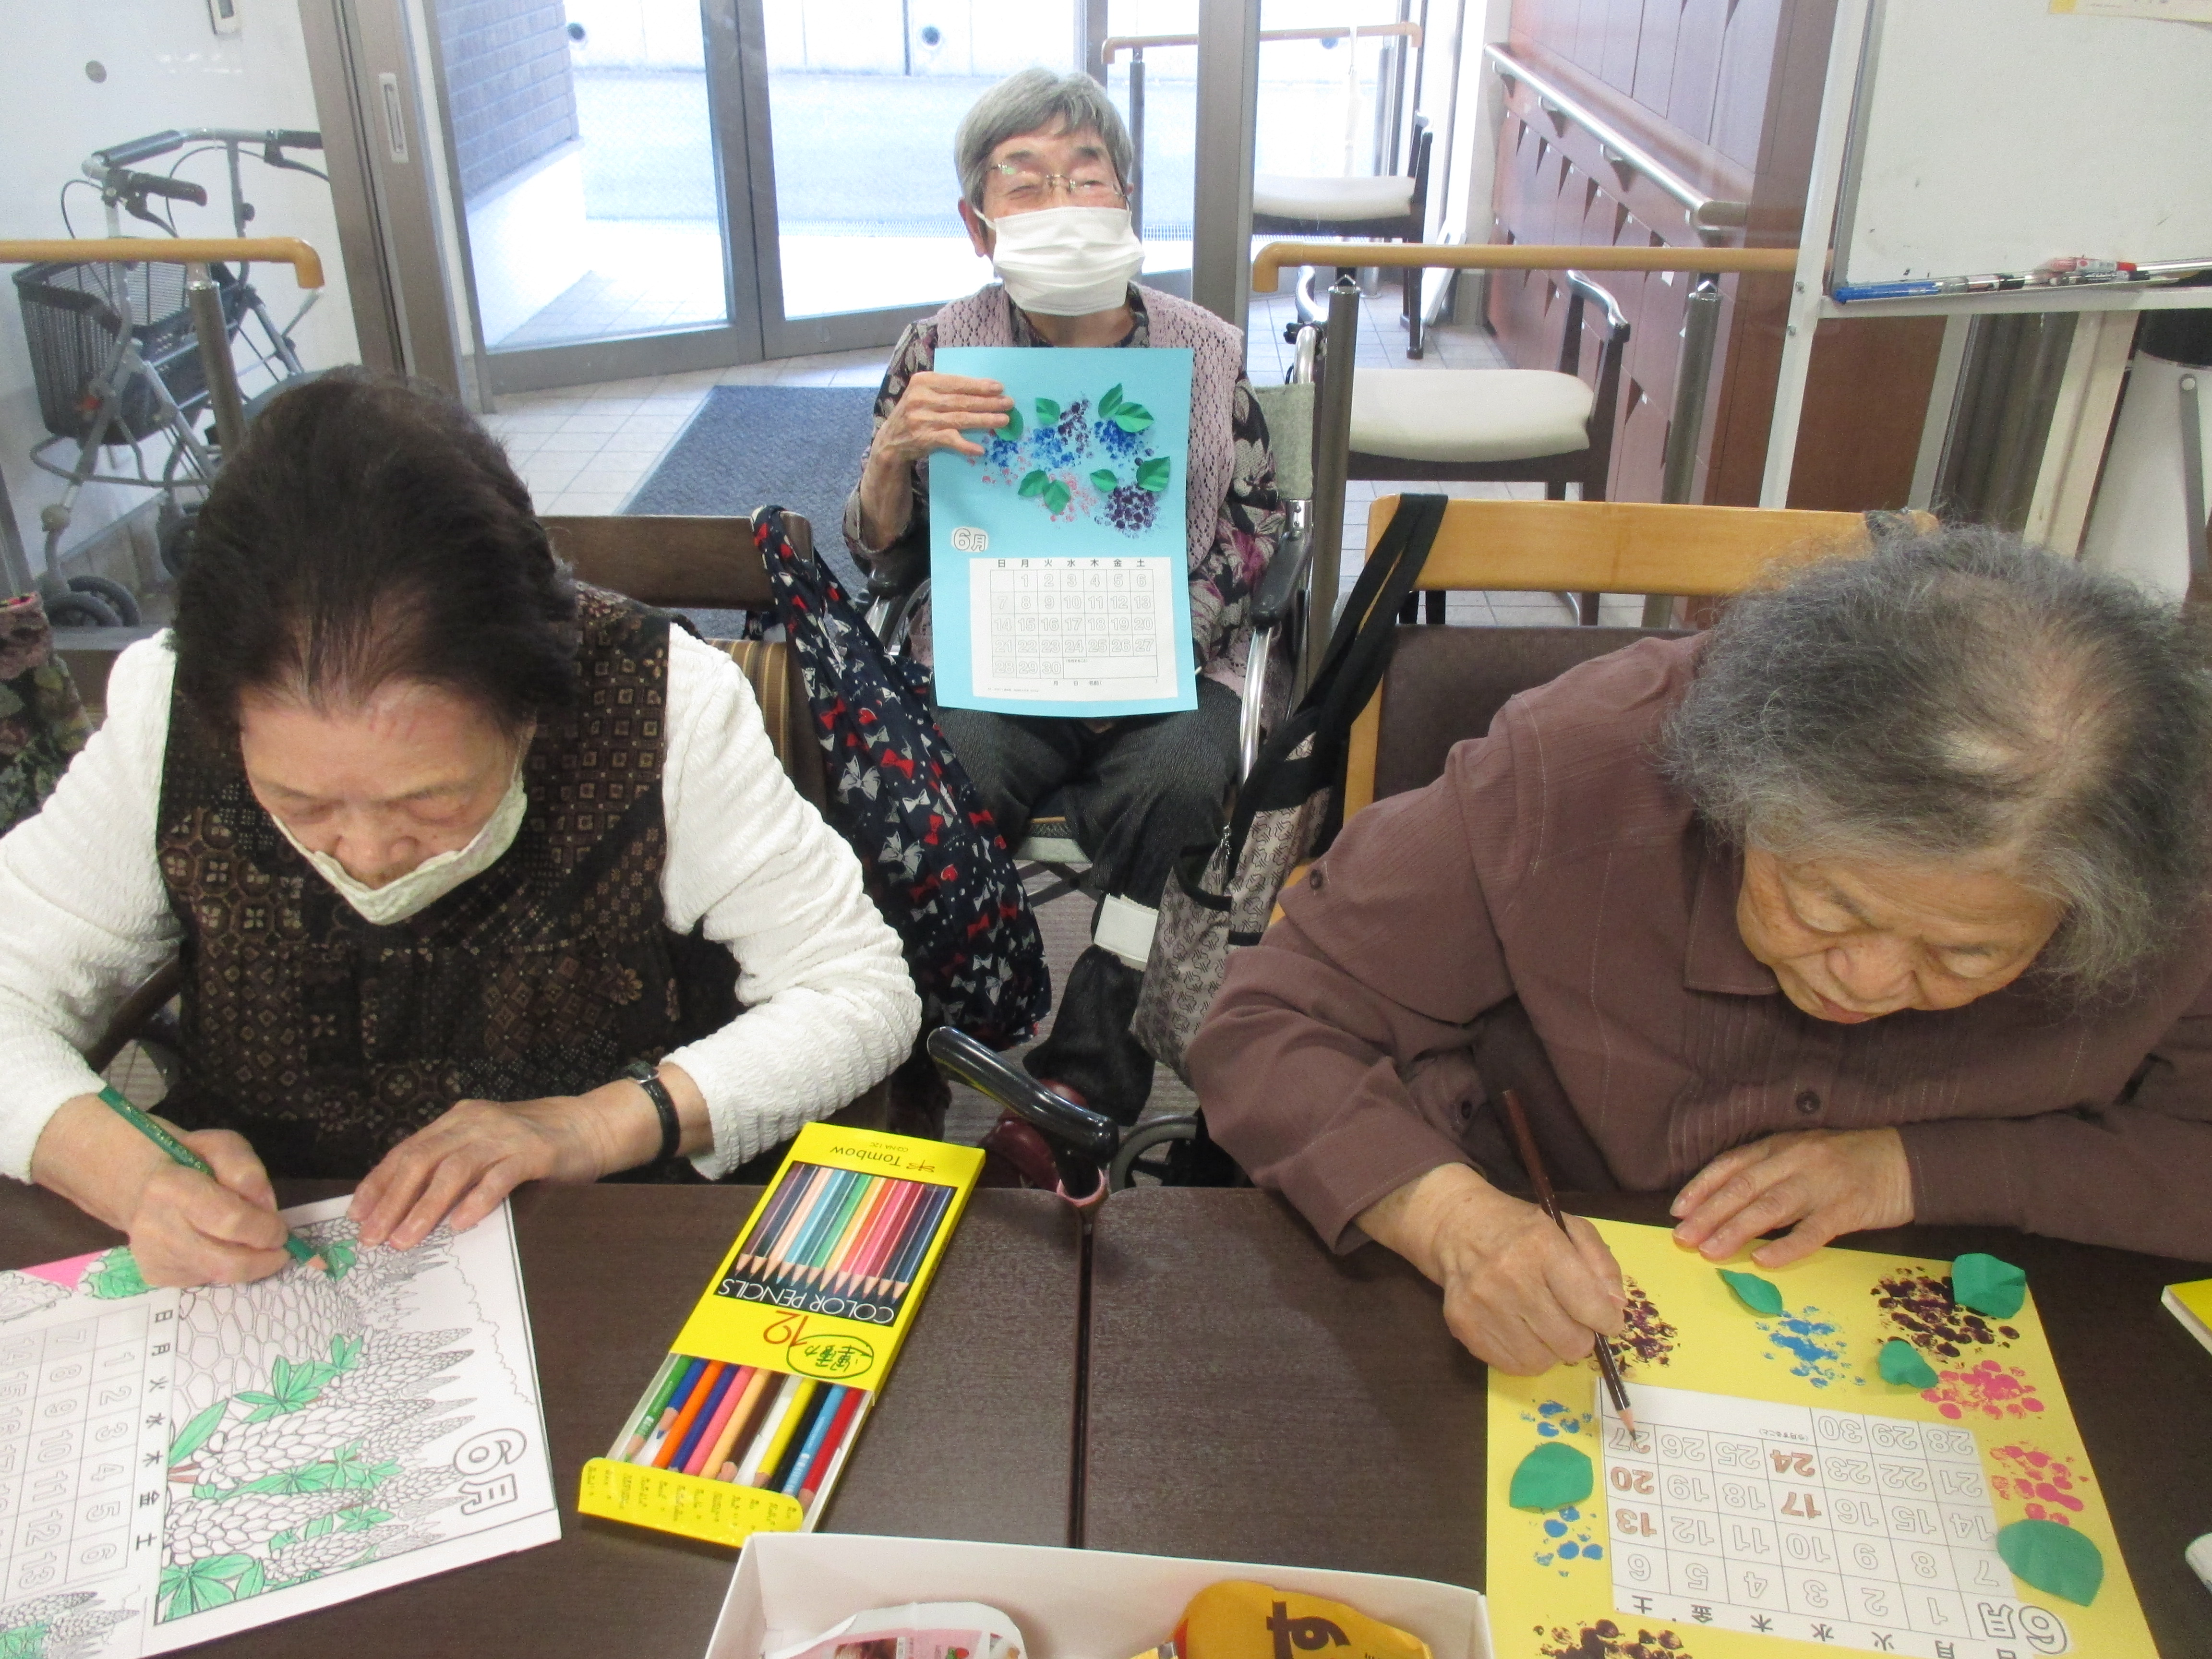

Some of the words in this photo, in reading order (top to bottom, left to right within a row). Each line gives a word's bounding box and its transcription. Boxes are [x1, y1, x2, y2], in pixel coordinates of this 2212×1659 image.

[953, 528, 986, 552] 6月
[998, 559, 1006, 567] 日
[1021, 559, 1029, 567] 月
[1045, 559, 1052, 567] 火
[1067, 559, 1075, 567] 水
[1091, 559, 1099, 567] 木
[1114, 559, 1122, 567] 金
[1022, 575, 1028, 587] 1
[1044, 574, 1054, 587] 2
[1067, 574, 1077, 587] 3
[1091, 574, 1100, 587] 4
[1114, 574, 1123, 587] 5
[1137, 574, 1146, 587] 6
[998, 596, 1007, 609] 7
[1022, 596, 1031, 609] 8
[1045, 596, 1054, 609] 9
[1064, 596, 1082, 609] 10
[1088, 596, 1103, 609] 11
[1110, 596, 1128, 609] 12
[1134, 596, 1151, 609] 13
[995, 618, 1011, 631] 14
[1018, 618, 1035, 631] 15
[1041, 618, 1059, 631] 16
[1065, 618, 1082, 630] 17
[1088, 618, 1106, 630] 18
[1111, 618, 1129, 630] 19
[1134, 617, 1153, 630] 20
[995, 640, 1011, 652] 21
[1018, 640, 1037, 653] 22
[1041, 640, 1060, 653] 23
[1065, 640, 1083, 653] 24
[1088, 639, 1107, 652] 25
[1112, 639, 1130, 652] 26
[1135, 639, 1154, 652] 27
[995, 661, 1014, 673] 28
[1019, 661, 1038, 674] 29
[1042, 661, 1061, 674] 30
[830, 1146, 901, 1167] Tombow
[718, 1278, 807, 1309] PENCILS
[156, 1310, 173, 1322] 日
[810, 1295, 894, 1323] COLOR
[57, 1328, 86, 1343] 7
[763, 1310, 809, 1346] 12
[104, 1352, 135, 1367] 1
[152, 1343, 170, 1356] 月
[50, 1364, 82, 1382] 8
[150, 1376, 168, 1392] 火
[45, 1399, 77, 1416] 9
[100, 1386, 132, 1406] 2
[96, 1422, 128, 1442] 3
[146, 1412, 165, 1429] 水
[1818, 1415, 1862, 1443] 30
[38, 1430, 72, 1462] 10
[1609, 1428, 1650, 1454] 27
[1661, 1434, 1705, 1461] 26
[1872, 1423, 1917, 1450] 29
[1926, 1429, 1973, 1455] 28
[143, 1450, 163, 1467] 木
[1716, 1442, 1760, 1470] 25
[1770, 1449, 1815, 1477] 24
[92, 1464, 124, 1481] 4
[453, 1428, 528, 1515] 6月
[1611, 1467, 1654, 1494] 20
[1825, 1456, 1871, 1484] 23
[1879, 1463, 1927, 1491] 22
[33, 1471, 68, 1502] 11
[1667, 1475, 1709, 1502] 19
[1722, 1482, 1765, 1510] 18
[1940, 1470, 1982, 1498] 21
[87, 1501, 120, 1522] 5
[140, 1491, 160, 1508] 金
[1781, 1491, 1822, 1519] 17
[1835, 1499, 1879, 1527] 16
[26, 1509, 62, 1547] 12
[1615, 1508, 1657, 1537] 13
[1671, 1516, 1714, 1546] 12
[1892, 1506, 1936, 1534] 15
[1950, 1513, 1996, 1542] 14
[136, 1532, 157, 1551] 土
[1733, 1525, 1769, 1553] 11
[1787, 1533, 1830, 1562] 10
[81, 1543, 117, 1564] 6
[1628, 1553, 1651, 1581] 6
[1853, 1543, 1878, 1570] 9
[1911, 1551, 1937, 1578] 8
[19, 1551, 57, 1589] 13
[1685, 1563, 1708, 1591] 5
[1974, 1560, 1999, 1587] 7
[1744, 1571, 1767, 1599] 4
[1803, 1579, 1828, 1608] 3
[1632, 1595, 1653, 1614] 土
[1691, 1604, 1713, 1623] 金
[1862, 1587, 1888, 1616] 2
[1927, 1597, 1948, 1624] 1
[1750, 1614, 1773, 1632] 木
[1810, 1623, 1834, 1641] 水
[1978, 1602, 2068, 1654] 6月
[1872, 1631, 1895, 1650] 火
[1935, 1640, 1955, 1659] 月
